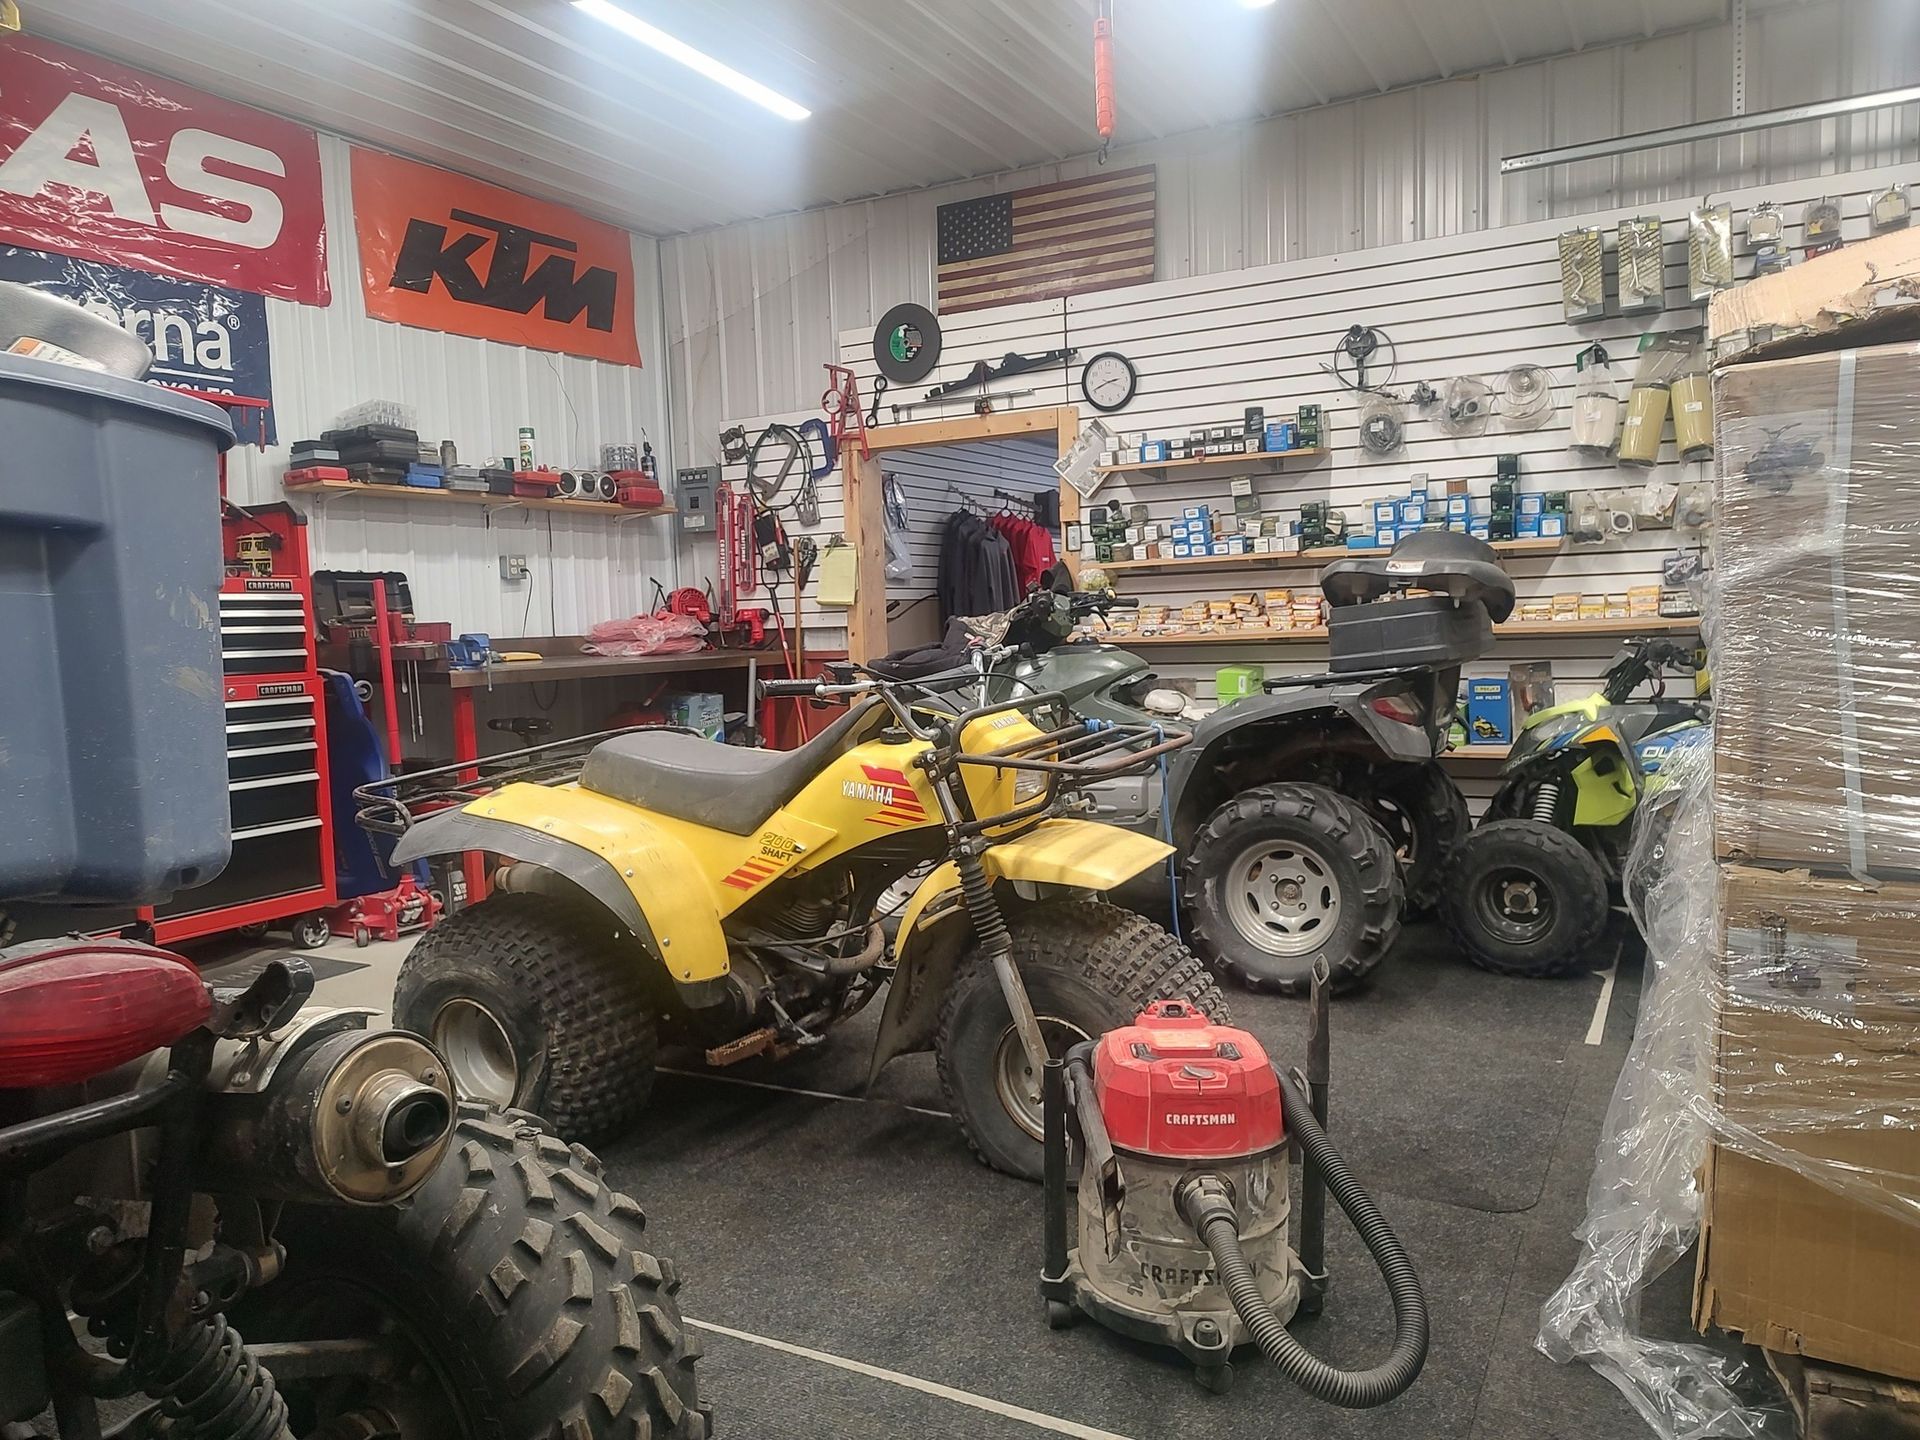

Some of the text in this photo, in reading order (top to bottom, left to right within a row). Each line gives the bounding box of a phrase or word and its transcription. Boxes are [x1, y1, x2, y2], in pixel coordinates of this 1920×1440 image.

[389, 208, 618, 333] KTM
[247, 581, 290, 591] CRAFTSMAN
[260, 684, 302, 695] CRAFTSMAN
[841, 780, 893, 805] YAMAHA
[760, 832, 796, 850] 200
[761, 846, 793, 862] SHAFT
[1166, 1113, 1236, 1125] CRAFTSMAN
[1140, 1261, 1258, 1287] CRAFTSN
